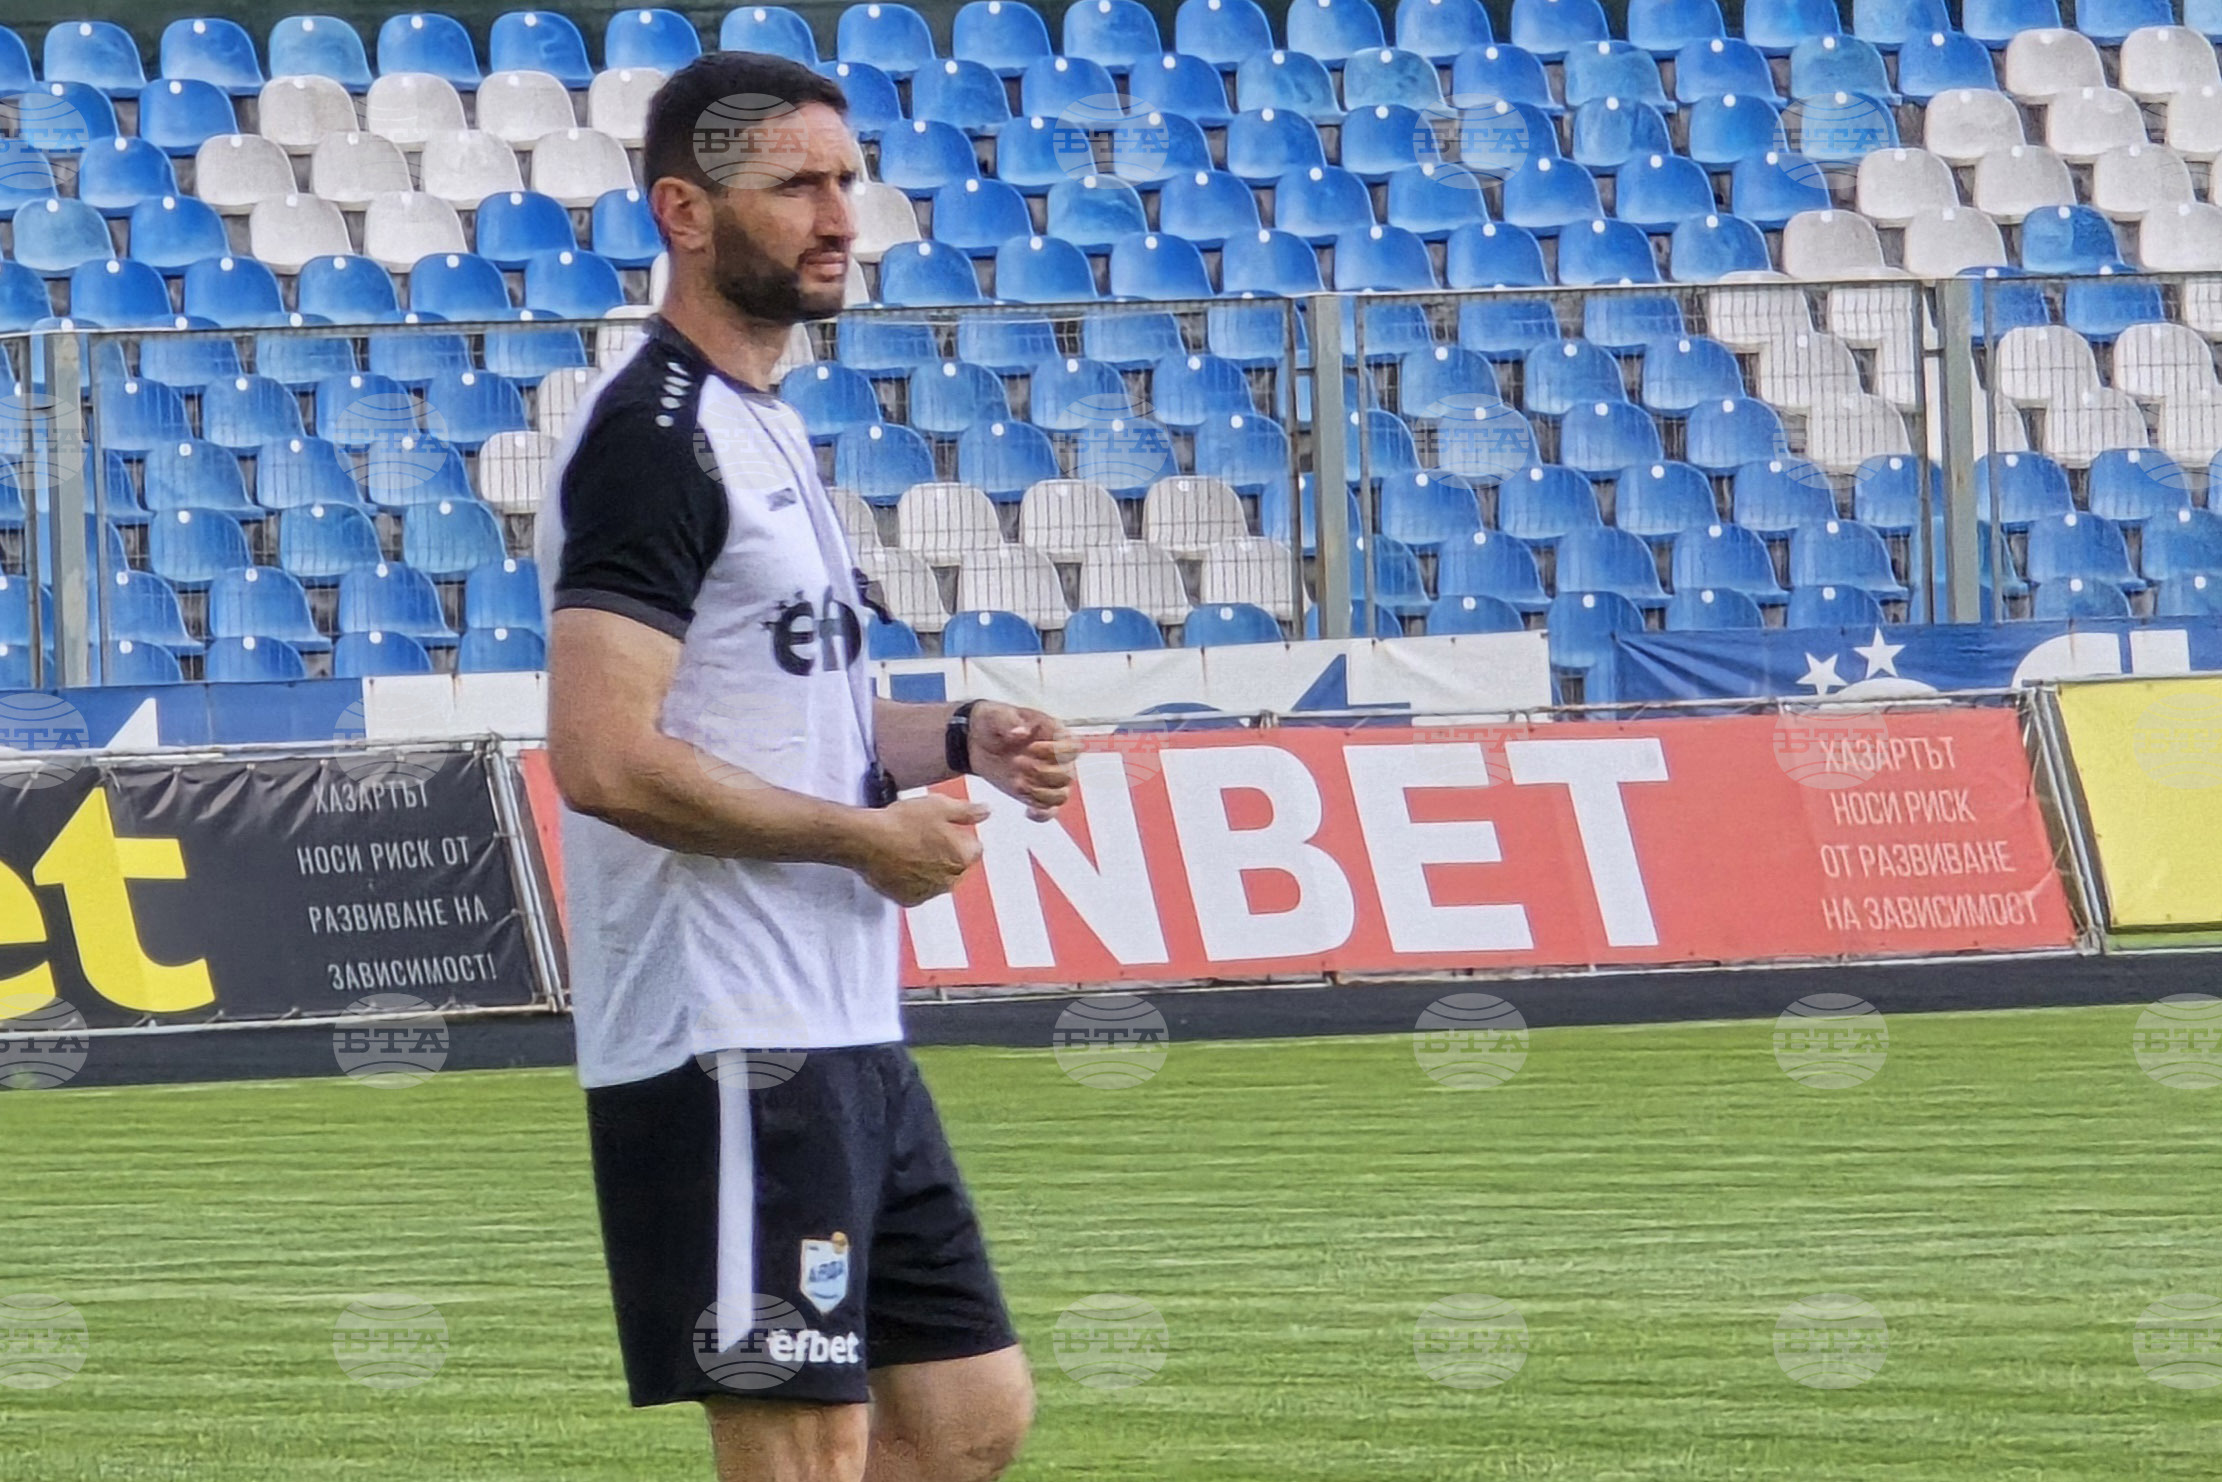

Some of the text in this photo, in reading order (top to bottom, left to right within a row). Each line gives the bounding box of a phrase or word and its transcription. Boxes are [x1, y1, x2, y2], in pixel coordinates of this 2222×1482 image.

[1819, 736, 1956, 773] ХАЗАРТЪТ
[313, 780, 428, 814] ХАЗАРТЪТ
[1830, 789, 1976, 825] НОСИ РИСК
[297, 836, 469, 875] НОСИ РИСК ОТ
[1820, 840, 2016, 878] ОТ РАЗВИВАНЕ
[308, 894, 489, 934] РАЗВИВАНЕ НА
[1821, 890, 2038, 931] НА ЗАВИСИМОСТ
[327, 952, 498, 990] ЗАВИСИМОСТ!
